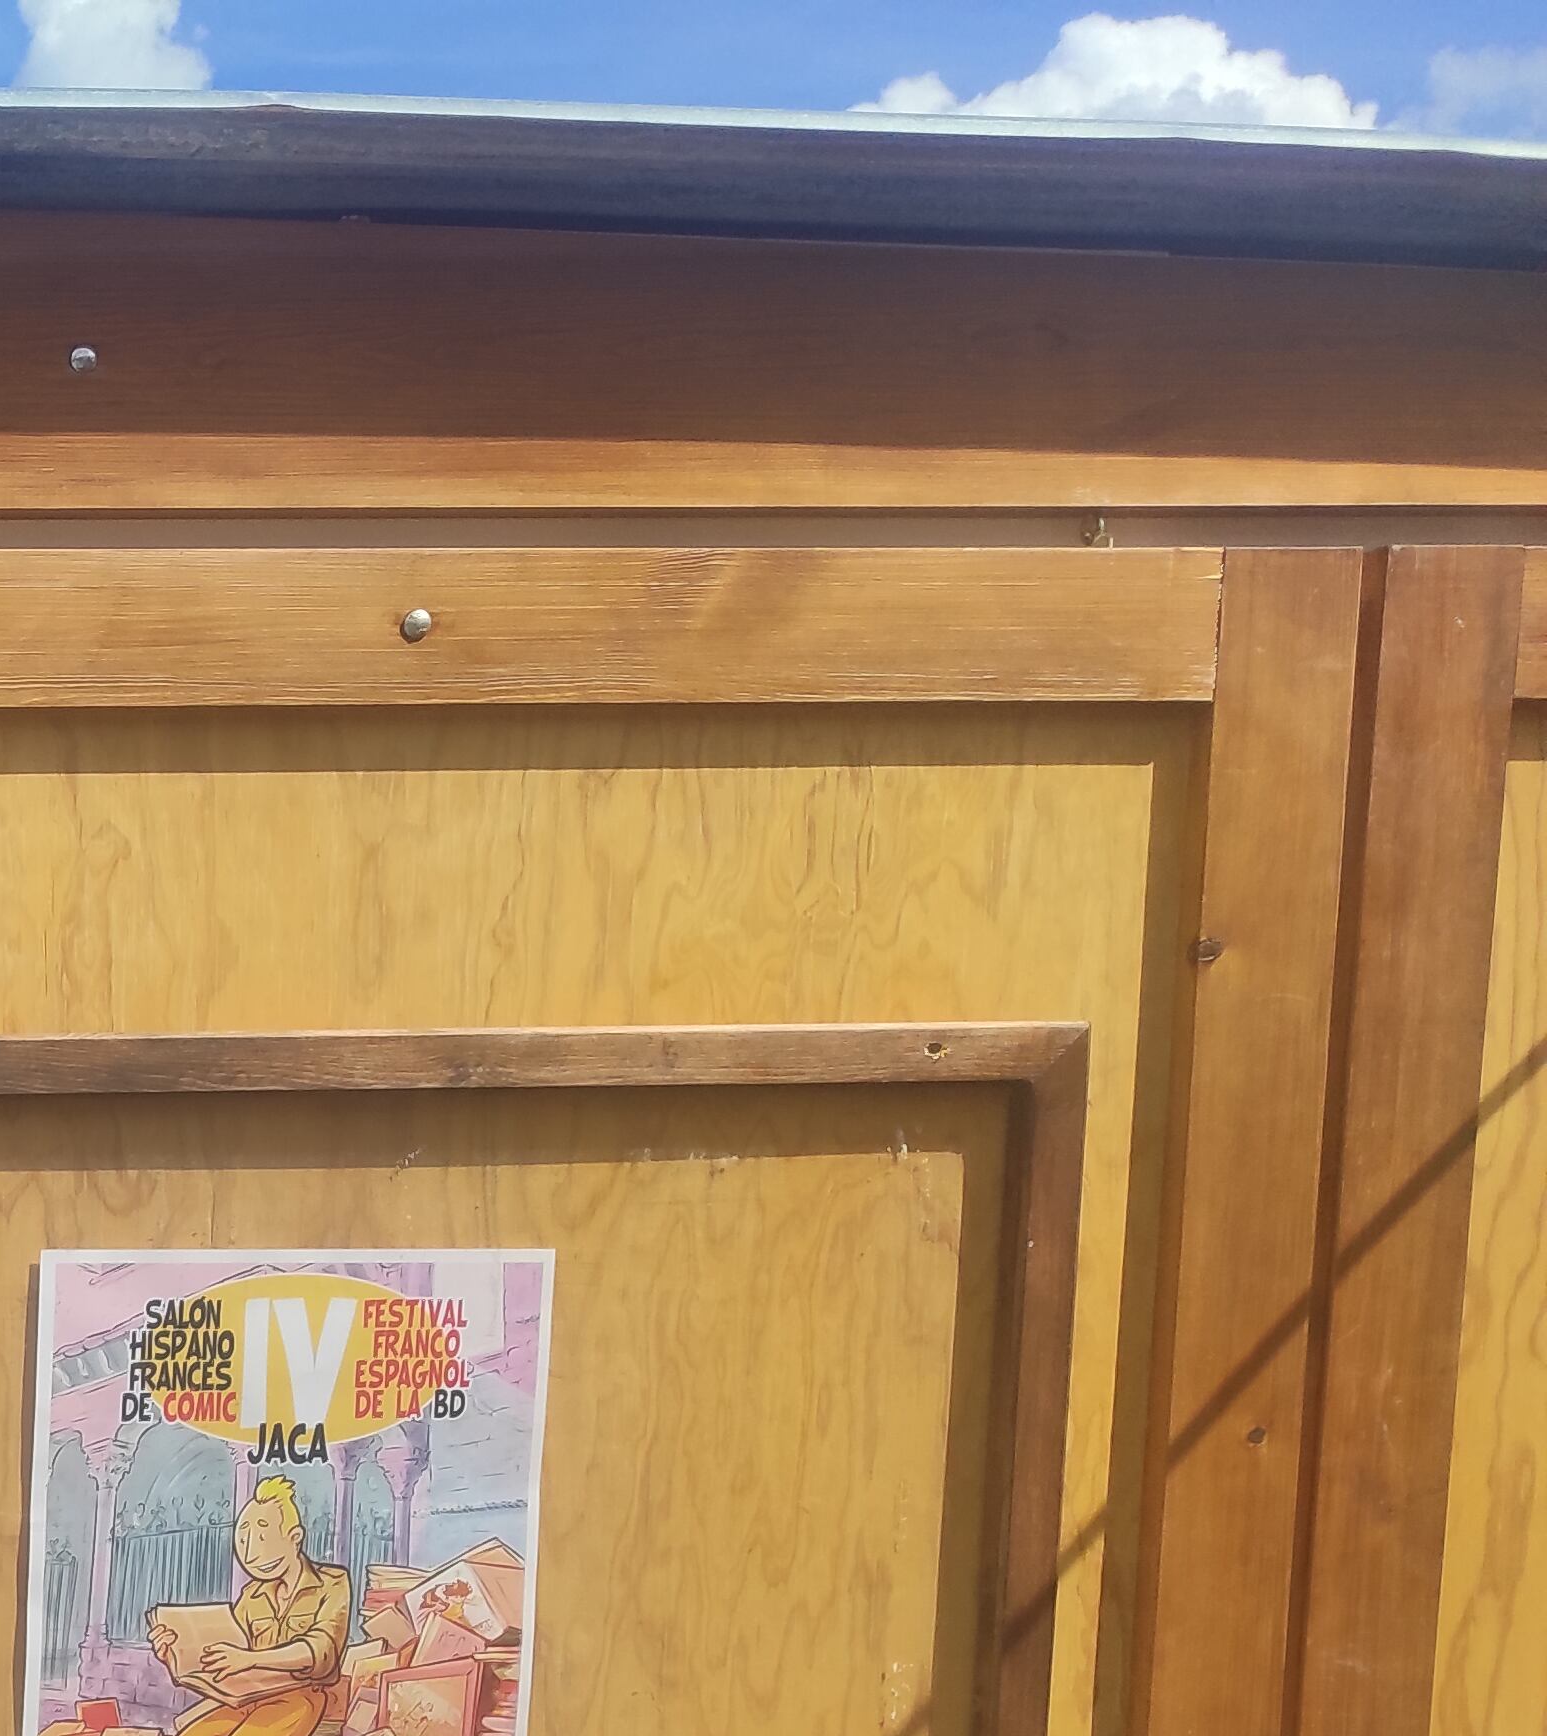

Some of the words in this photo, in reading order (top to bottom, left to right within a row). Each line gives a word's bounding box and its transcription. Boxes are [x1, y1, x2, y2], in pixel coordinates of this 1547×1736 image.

[145, 1296, 223, 1330] SALÓN
[362, 1299, 468, 1329] FESTIVAL
[129, 1329, 235, 1361] HISPANO
[372, 1329, 462, 1359] FRANCO
[240, 1297, 358, 1429] IV
[354, 1359, 470, 1389] ESPAGNOL
[121, 1392, 153, 1422] DE
[354, 1389, 384, 1419] DE
[395, 1389, 422, 1419] LA
[433, 1389, 466, 1419] BD
[247, 1422, 329, 1465] JACA
